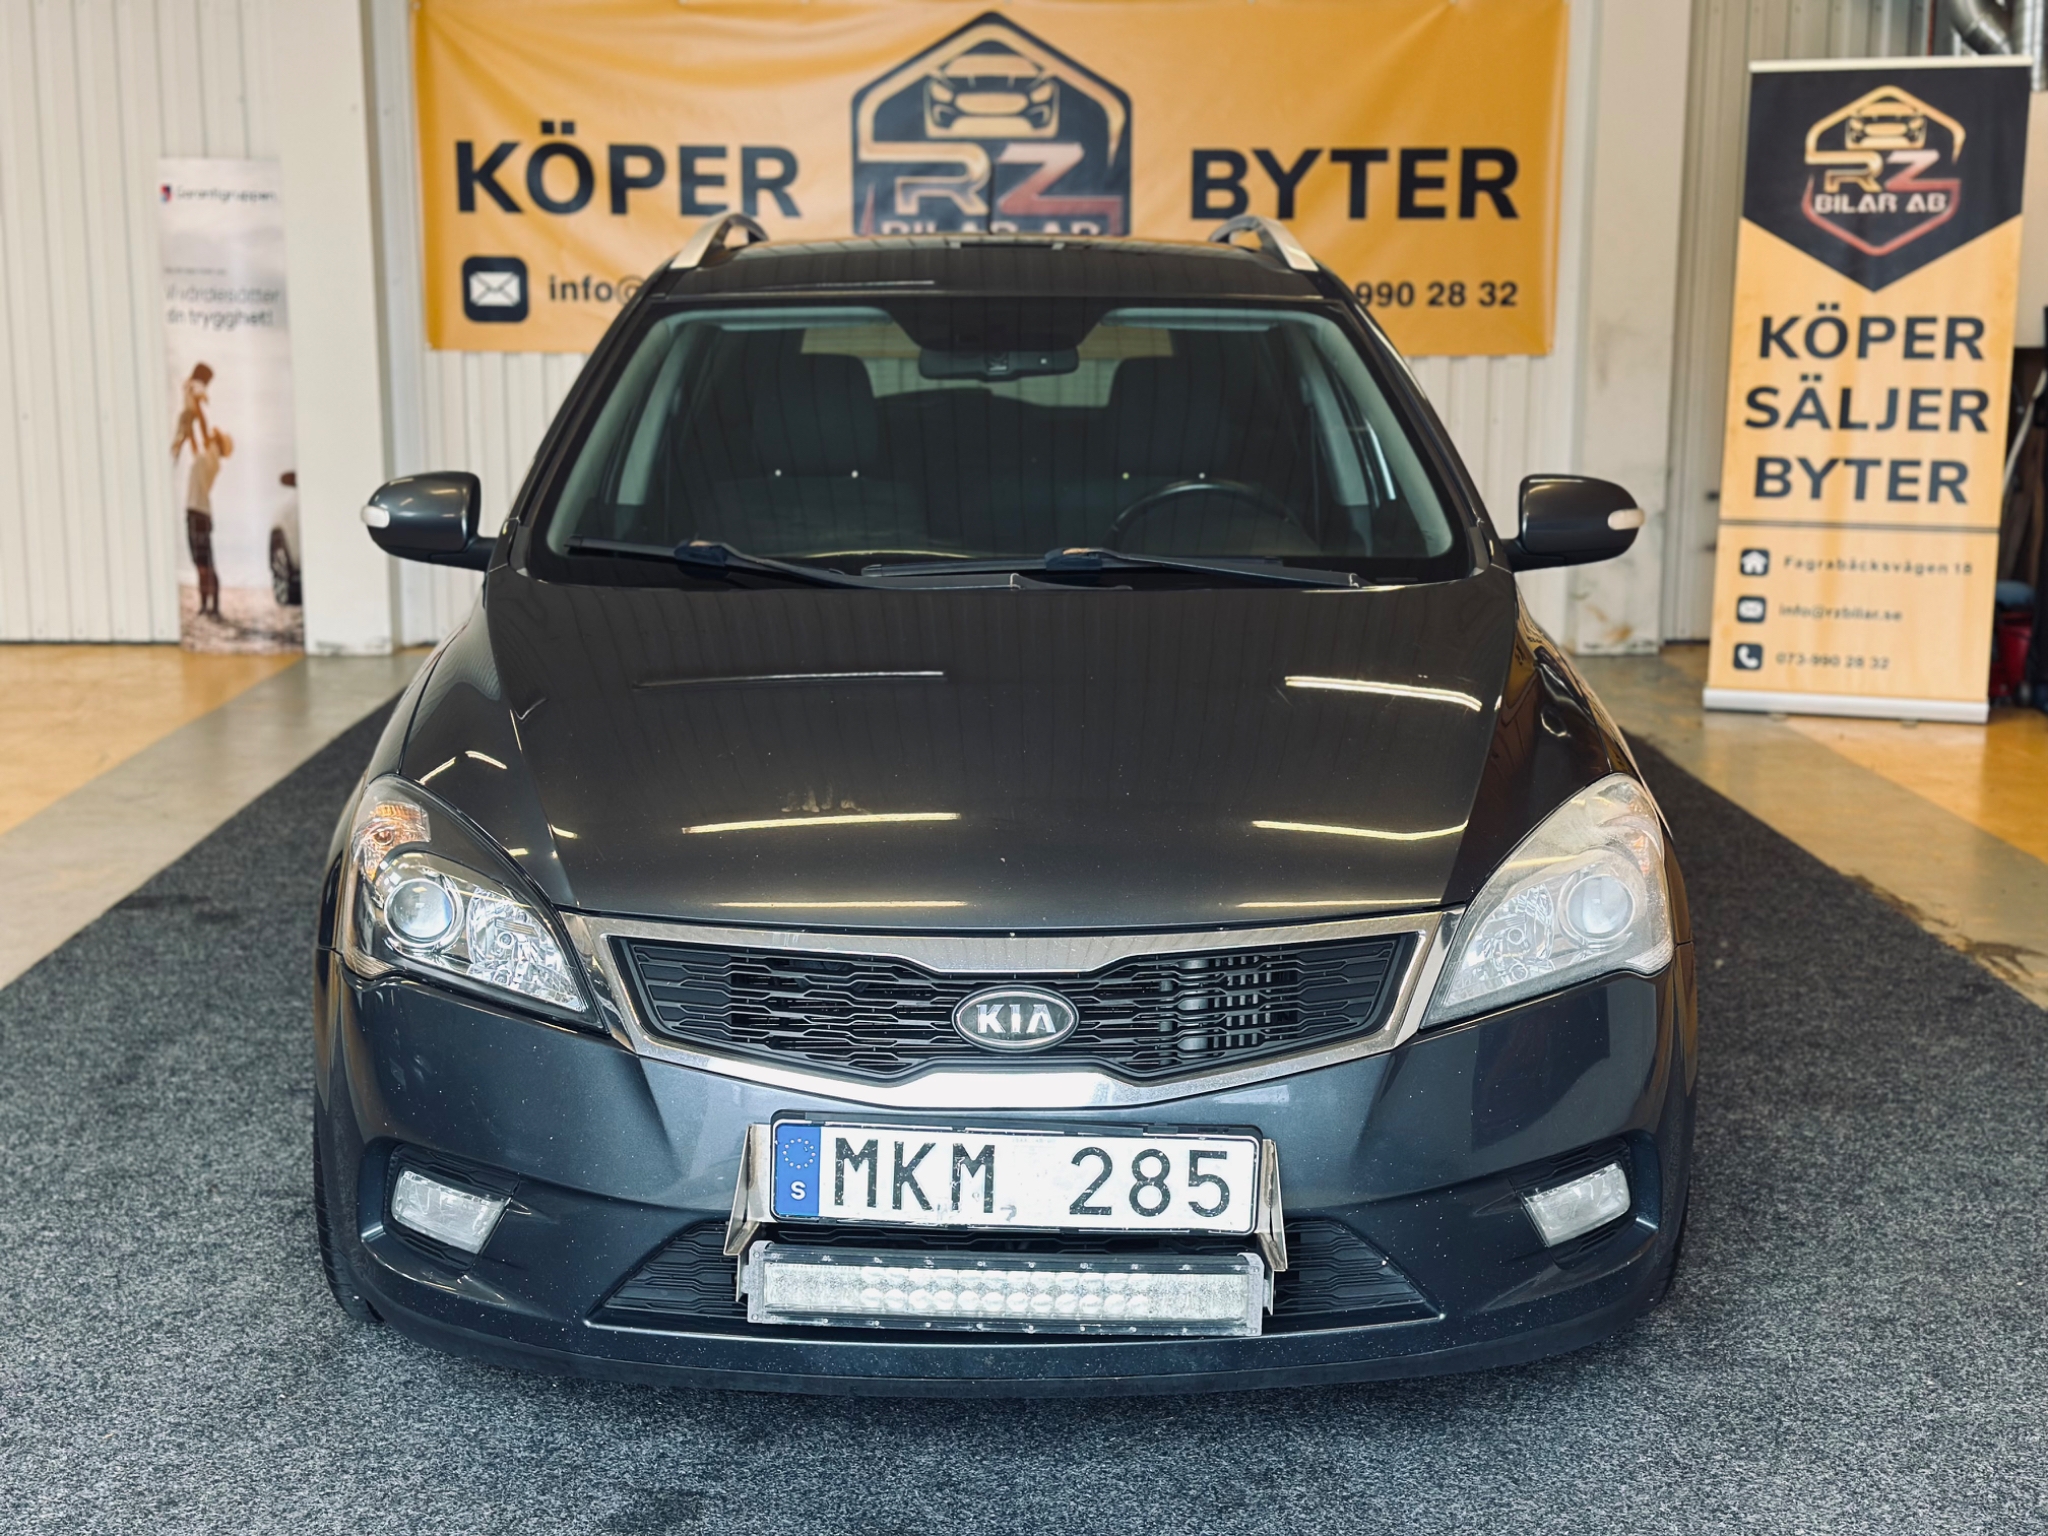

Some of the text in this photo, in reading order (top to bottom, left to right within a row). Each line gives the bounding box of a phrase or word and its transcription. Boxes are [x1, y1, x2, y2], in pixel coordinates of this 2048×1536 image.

[455, 120, 803, 218] KÖPER
[1190, 147, 1520, 220] BYTER
[1814, 193, 1947, 214] BILAR AB
[1427, 281, 1466, 307] 28
[1479, 281, 1518, 307] 32
[1759, 302, 1986, 360] KÖPER
[1744, 373, 1990, 433] SÄLJER
[1754, 456, 1970, 504] BYTER
[977, 1003, 1057, 1034] KIA
[790, 1181, 806, 1200] S
[834, 1137, 1230, 1218] MKM 285
